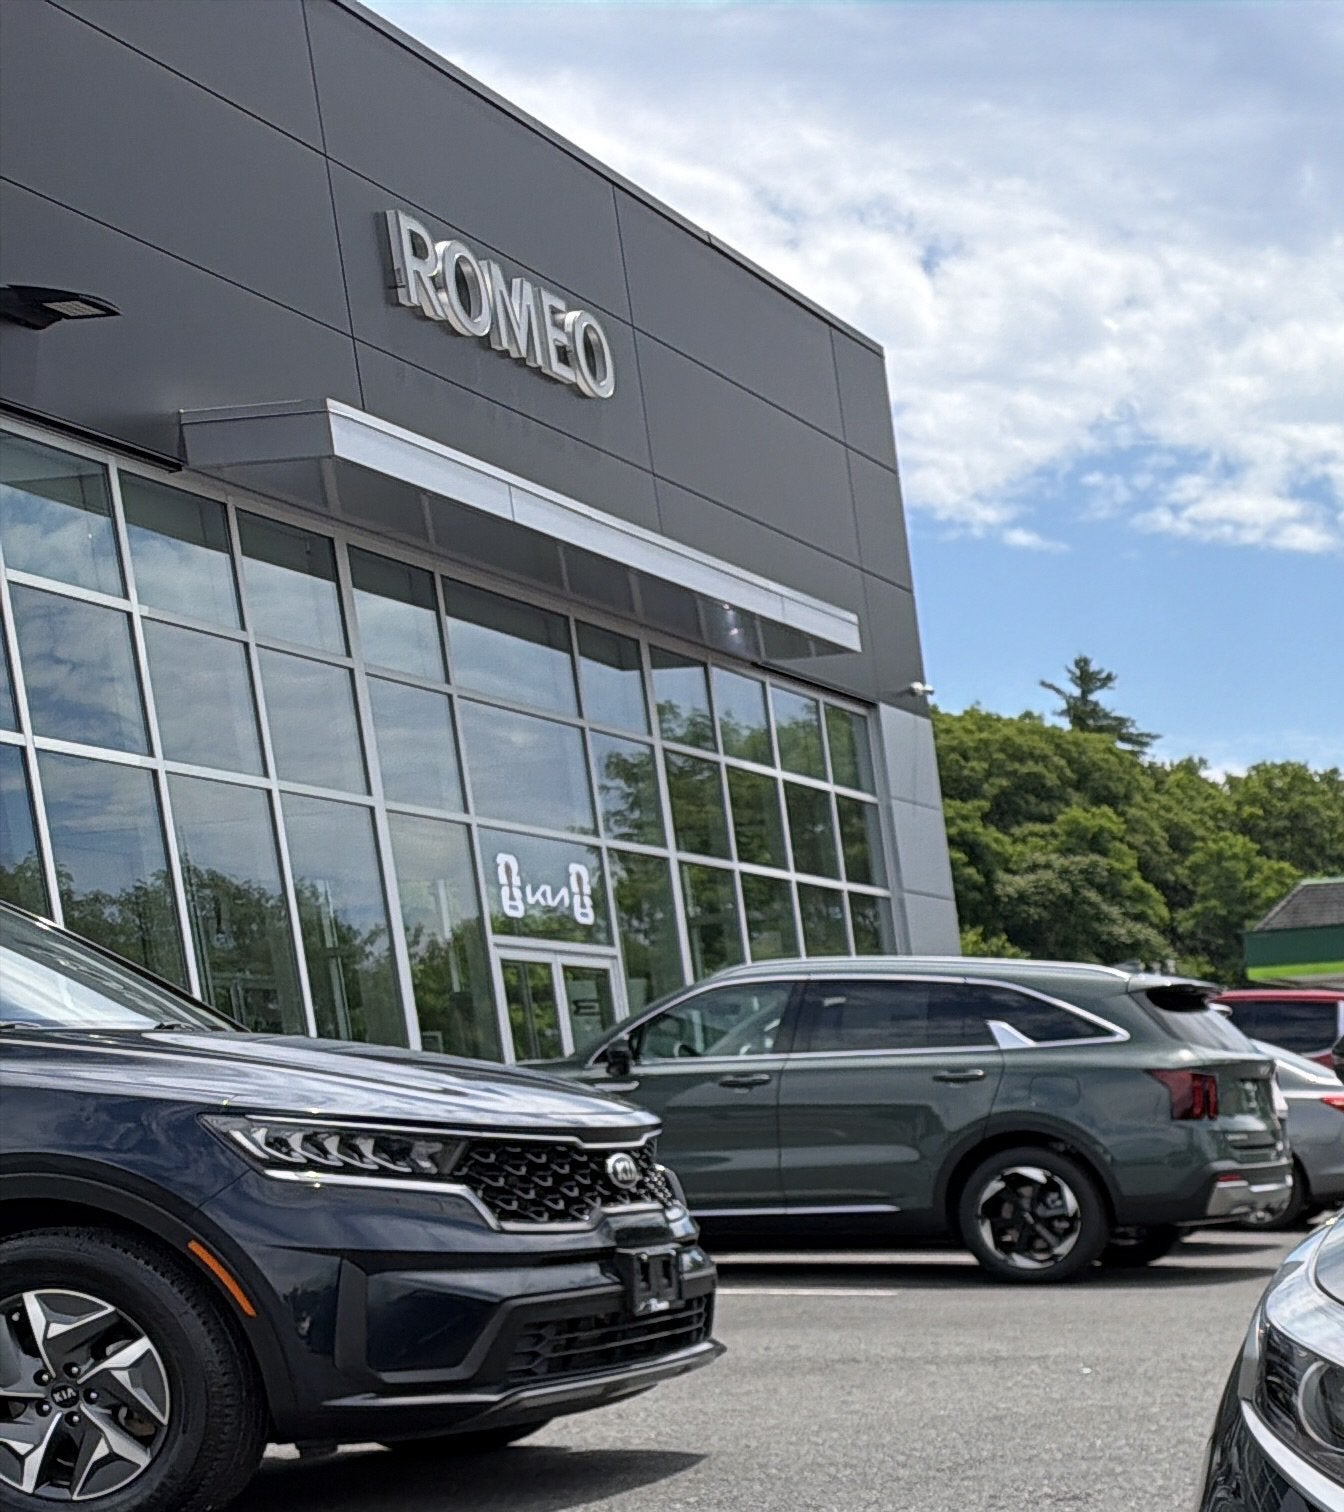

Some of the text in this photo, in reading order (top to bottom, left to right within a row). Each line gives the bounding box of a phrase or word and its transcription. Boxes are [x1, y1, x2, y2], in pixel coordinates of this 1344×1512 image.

[385, 210, 615, 398] ROMEO
[526, 884, 570, 908] KIA
[53, 1387, 77, 1403] KIA
